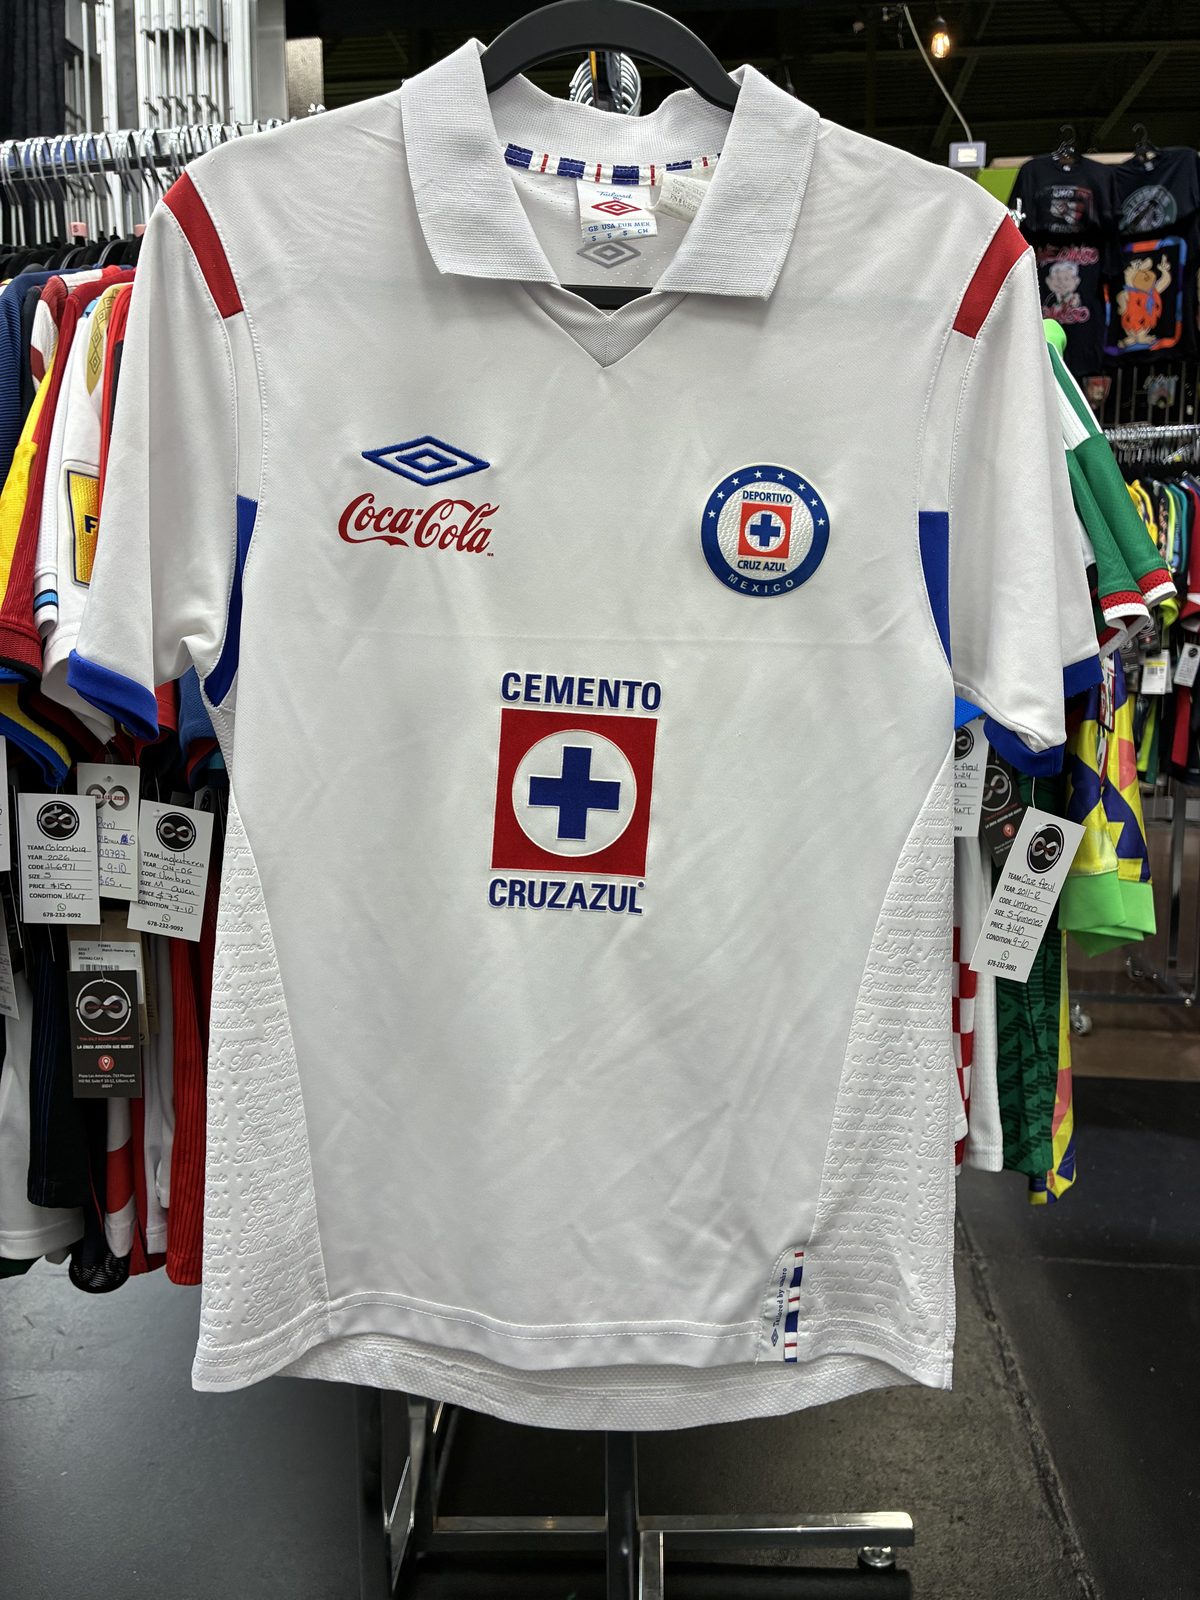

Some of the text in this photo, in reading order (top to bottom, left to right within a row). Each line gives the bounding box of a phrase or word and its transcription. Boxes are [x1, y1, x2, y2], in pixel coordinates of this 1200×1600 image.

[601, 223, 616, 231] USA
[742, 490, 793, 503] DEPORTIVO
[338, 492, 500, 553] Coca-Cola
[737, 559, 787, 572] CRUZ AZUL
[727, 573, 794, 593] MEXICO
[501, 671, 662, 712] CEMENTO
[45, 844, 87, 853] Colombia
[143, 851, 159, 859] TEAM
[1007, 872, 1022, 882] TEAM
[139, 889, 154, 897] PRICE
[1004, 884, 1016, 894] YEAR
[488, 877, 644, 915] CRUZAZUL
[138, 899, 169, 910] CONDITION
[999, 896, 1038, 912] CODE Umbro
[994, 908, 1005, 917] SIZE
[147, 920, 184, 932] 678-232-9092
[990, 920, 1004, 930] PRICE
[985, 932, 1012, 945] CONDITION
[987, 959, 1017, 972] 678-232-9092
